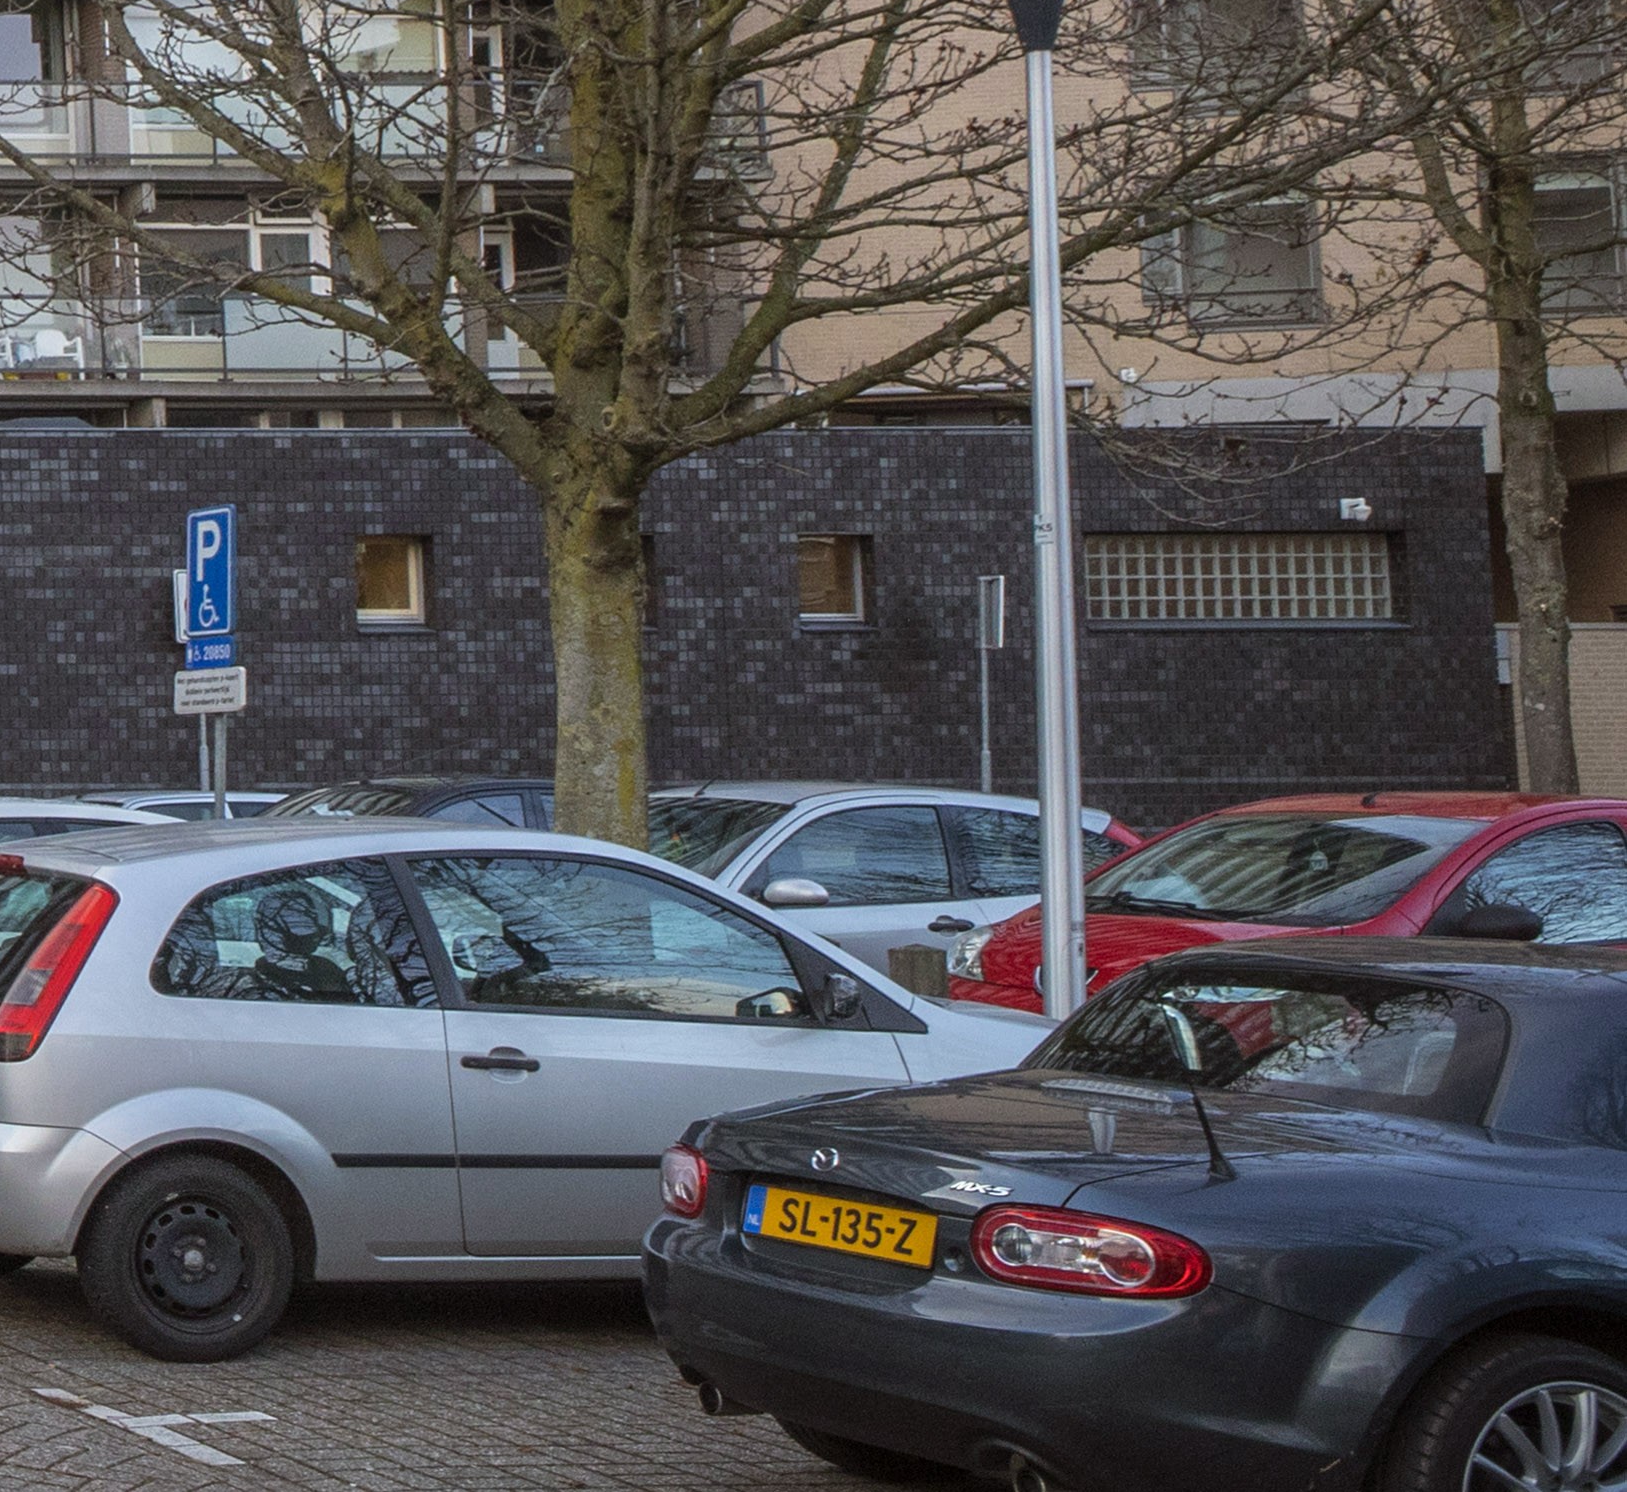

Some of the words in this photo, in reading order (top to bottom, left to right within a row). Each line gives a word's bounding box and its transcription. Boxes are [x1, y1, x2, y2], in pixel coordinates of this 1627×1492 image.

[196, 519, 222, 582] P
[949, 1180, 1015, 1198] MX-5
[778, 1197, 917, 1256] SL-135-Z
